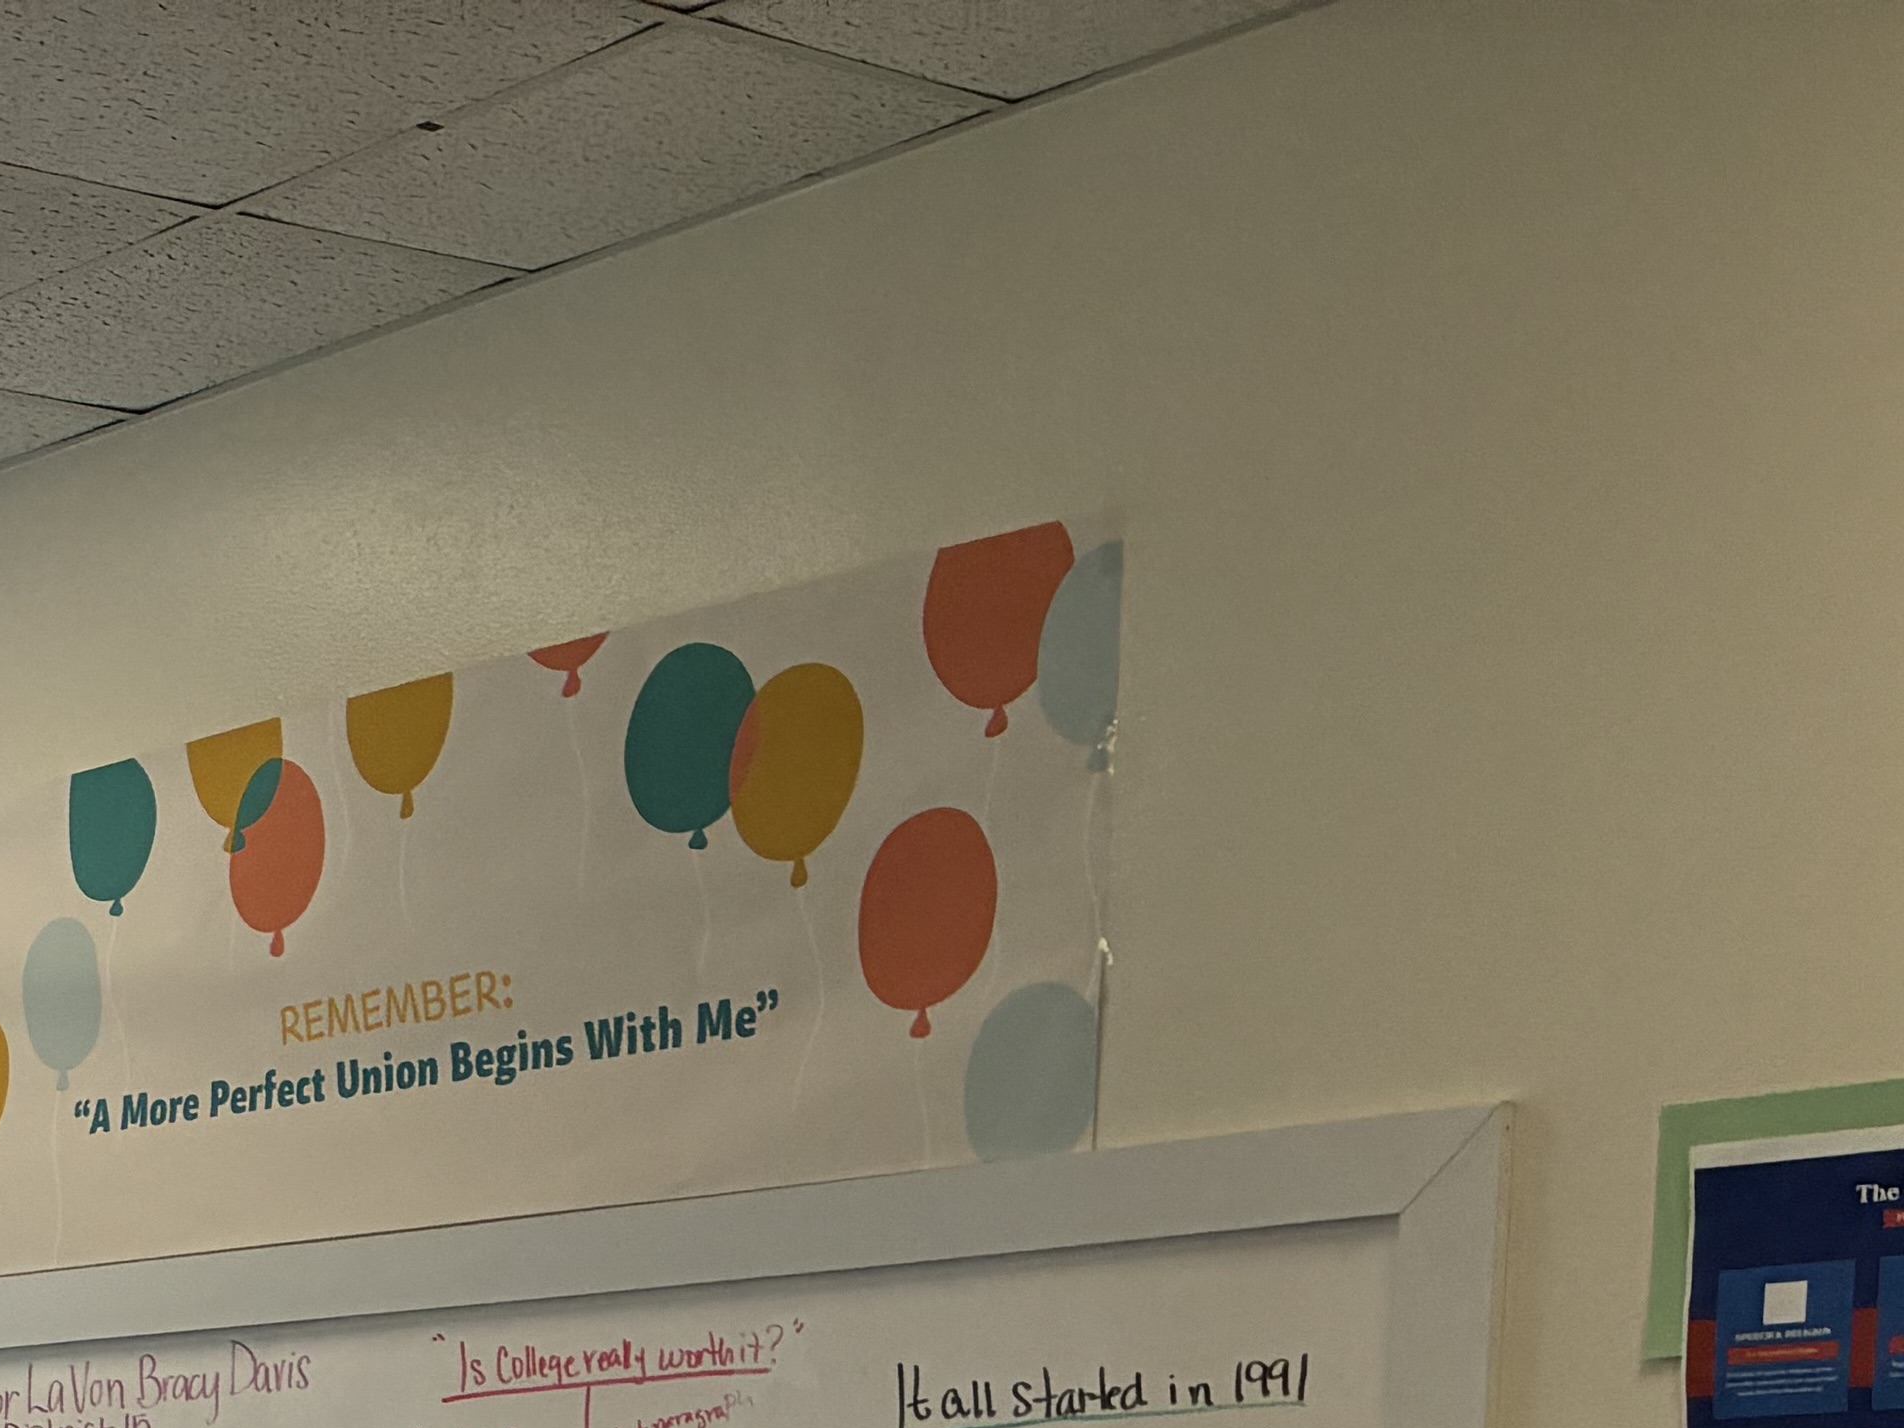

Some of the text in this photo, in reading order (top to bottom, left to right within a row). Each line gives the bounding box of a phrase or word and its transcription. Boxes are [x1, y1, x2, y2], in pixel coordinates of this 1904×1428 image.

[280, 970, 514, 1046] REMEMBER:
[120, 1092, 199, 1130] More
[208, 1069, 326, 1118] Perfect
[335, 1048, 440, 1100] Union
[449, 1030, 575, 1086] Begins
[583, 1005, 683, 1061] With
[1856, 1183, 1900, 1204] The
[138, 1354, 221, 1426] Bracy
[229, 1340, 312, 1396] Davis
[496, 1345, 580, 1387] College
[582, 1338, 646, 1380] really
[659, 1331, 735, 1372] worth
[941, 1380, 997, 1419] all
[1168, 1374, 1215, 1408] in
[1234, 1352, 1309, 1404] 1991
